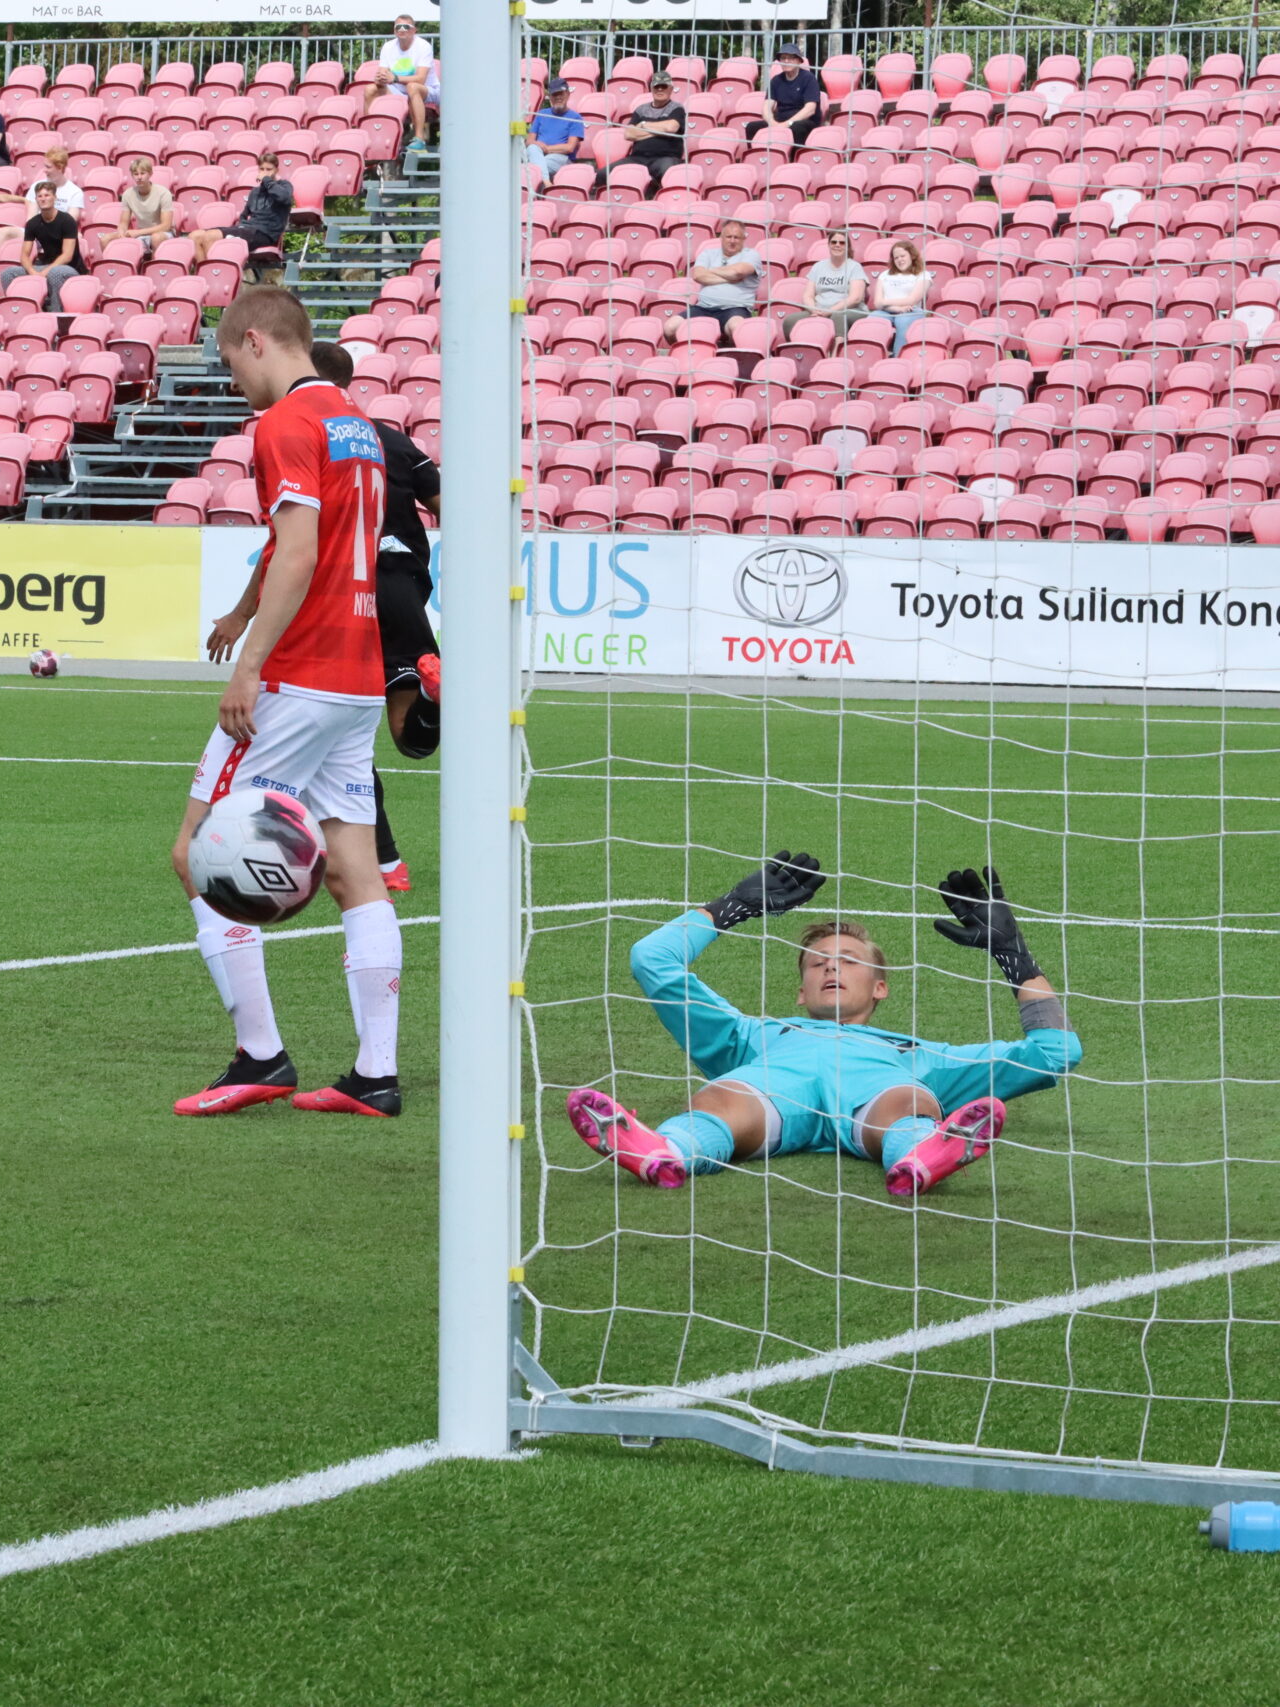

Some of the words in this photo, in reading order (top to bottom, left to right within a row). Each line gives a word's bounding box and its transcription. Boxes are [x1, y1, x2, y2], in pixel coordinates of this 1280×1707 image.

[32, 6, 58, 17] MAT
[76, 5, 103, 17] BAR
[259, 5, 286, 16] MAT
[305, 4, 333, 16] BAR
[891, 583, 1024, 628] Toyota
[1039, 586, 1184, 624] Sulland
[1200, 591, 1280, 637] Kon
[722, 636, 856, 665] TOYOTA
[252, 775, 297, 797] BETONG
